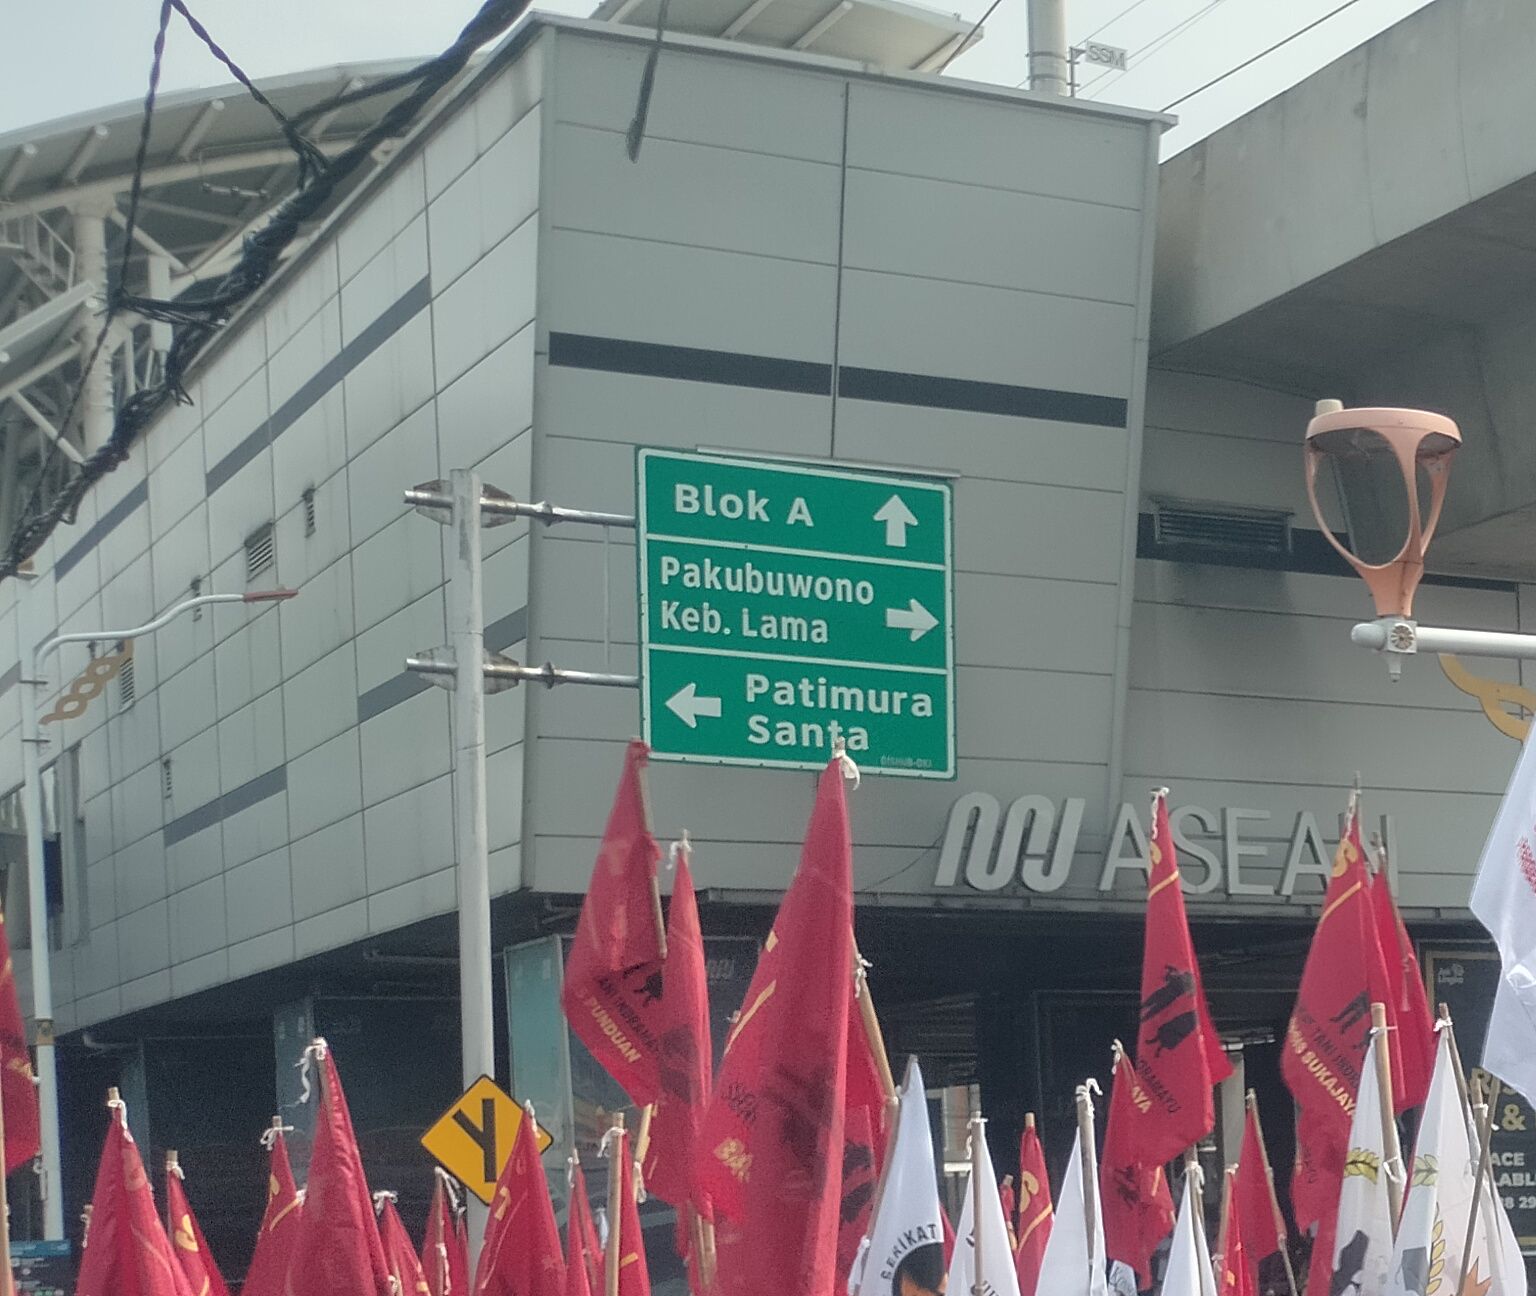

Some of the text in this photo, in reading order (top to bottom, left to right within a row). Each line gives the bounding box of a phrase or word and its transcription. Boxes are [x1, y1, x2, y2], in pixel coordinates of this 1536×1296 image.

[674, 483, 815, 527] Blok A
[660, 556, 875, 605] Pakubuwono
[661, 601, 829, 643] Keb. Lama
[746, 673, 933, 717] Patimura
[747, 715, 869, 750] Santa
[881, 1223, 937, 1281] SERIKAT
